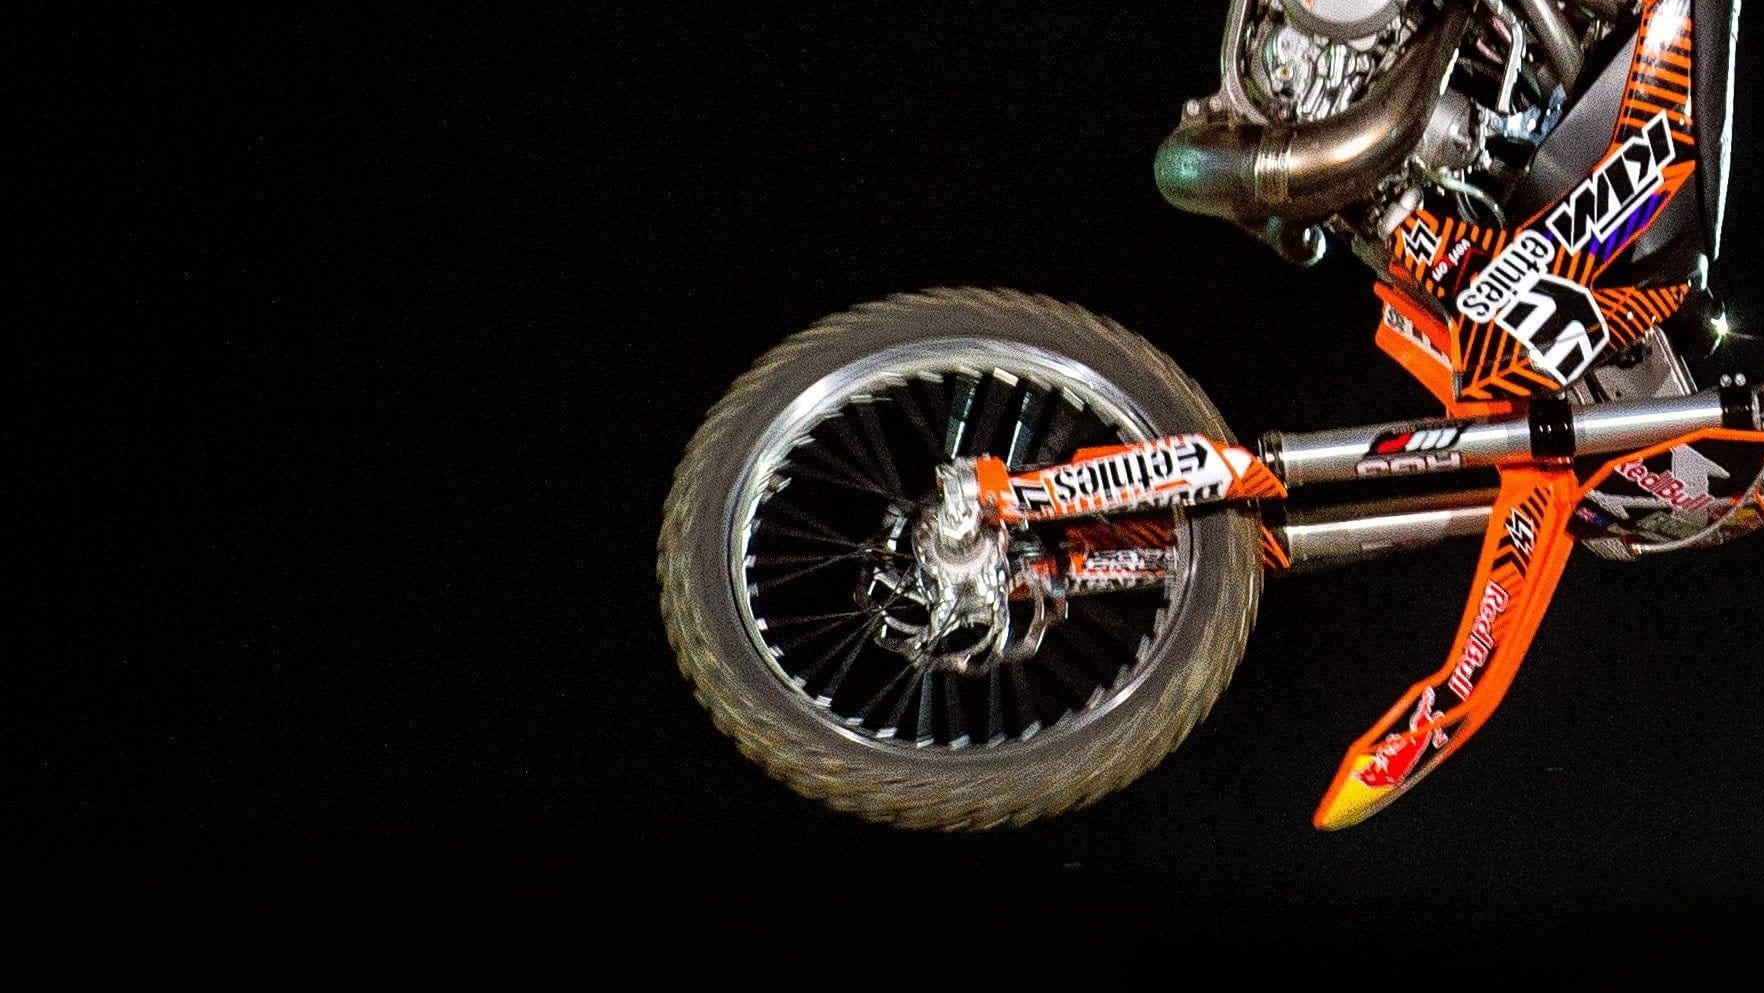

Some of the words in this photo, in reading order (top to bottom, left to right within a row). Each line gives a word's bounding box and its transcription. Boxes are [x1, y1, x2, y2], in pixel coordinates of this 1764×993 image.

[1546, 110, 1676, 255] KTM
[1459, 231, 1553, 321] etnies
[1054, 448, 1174, 503] etnies
[1471, 579, 1511, 651] Red
[1448, 634, 1490, 702] Bull
